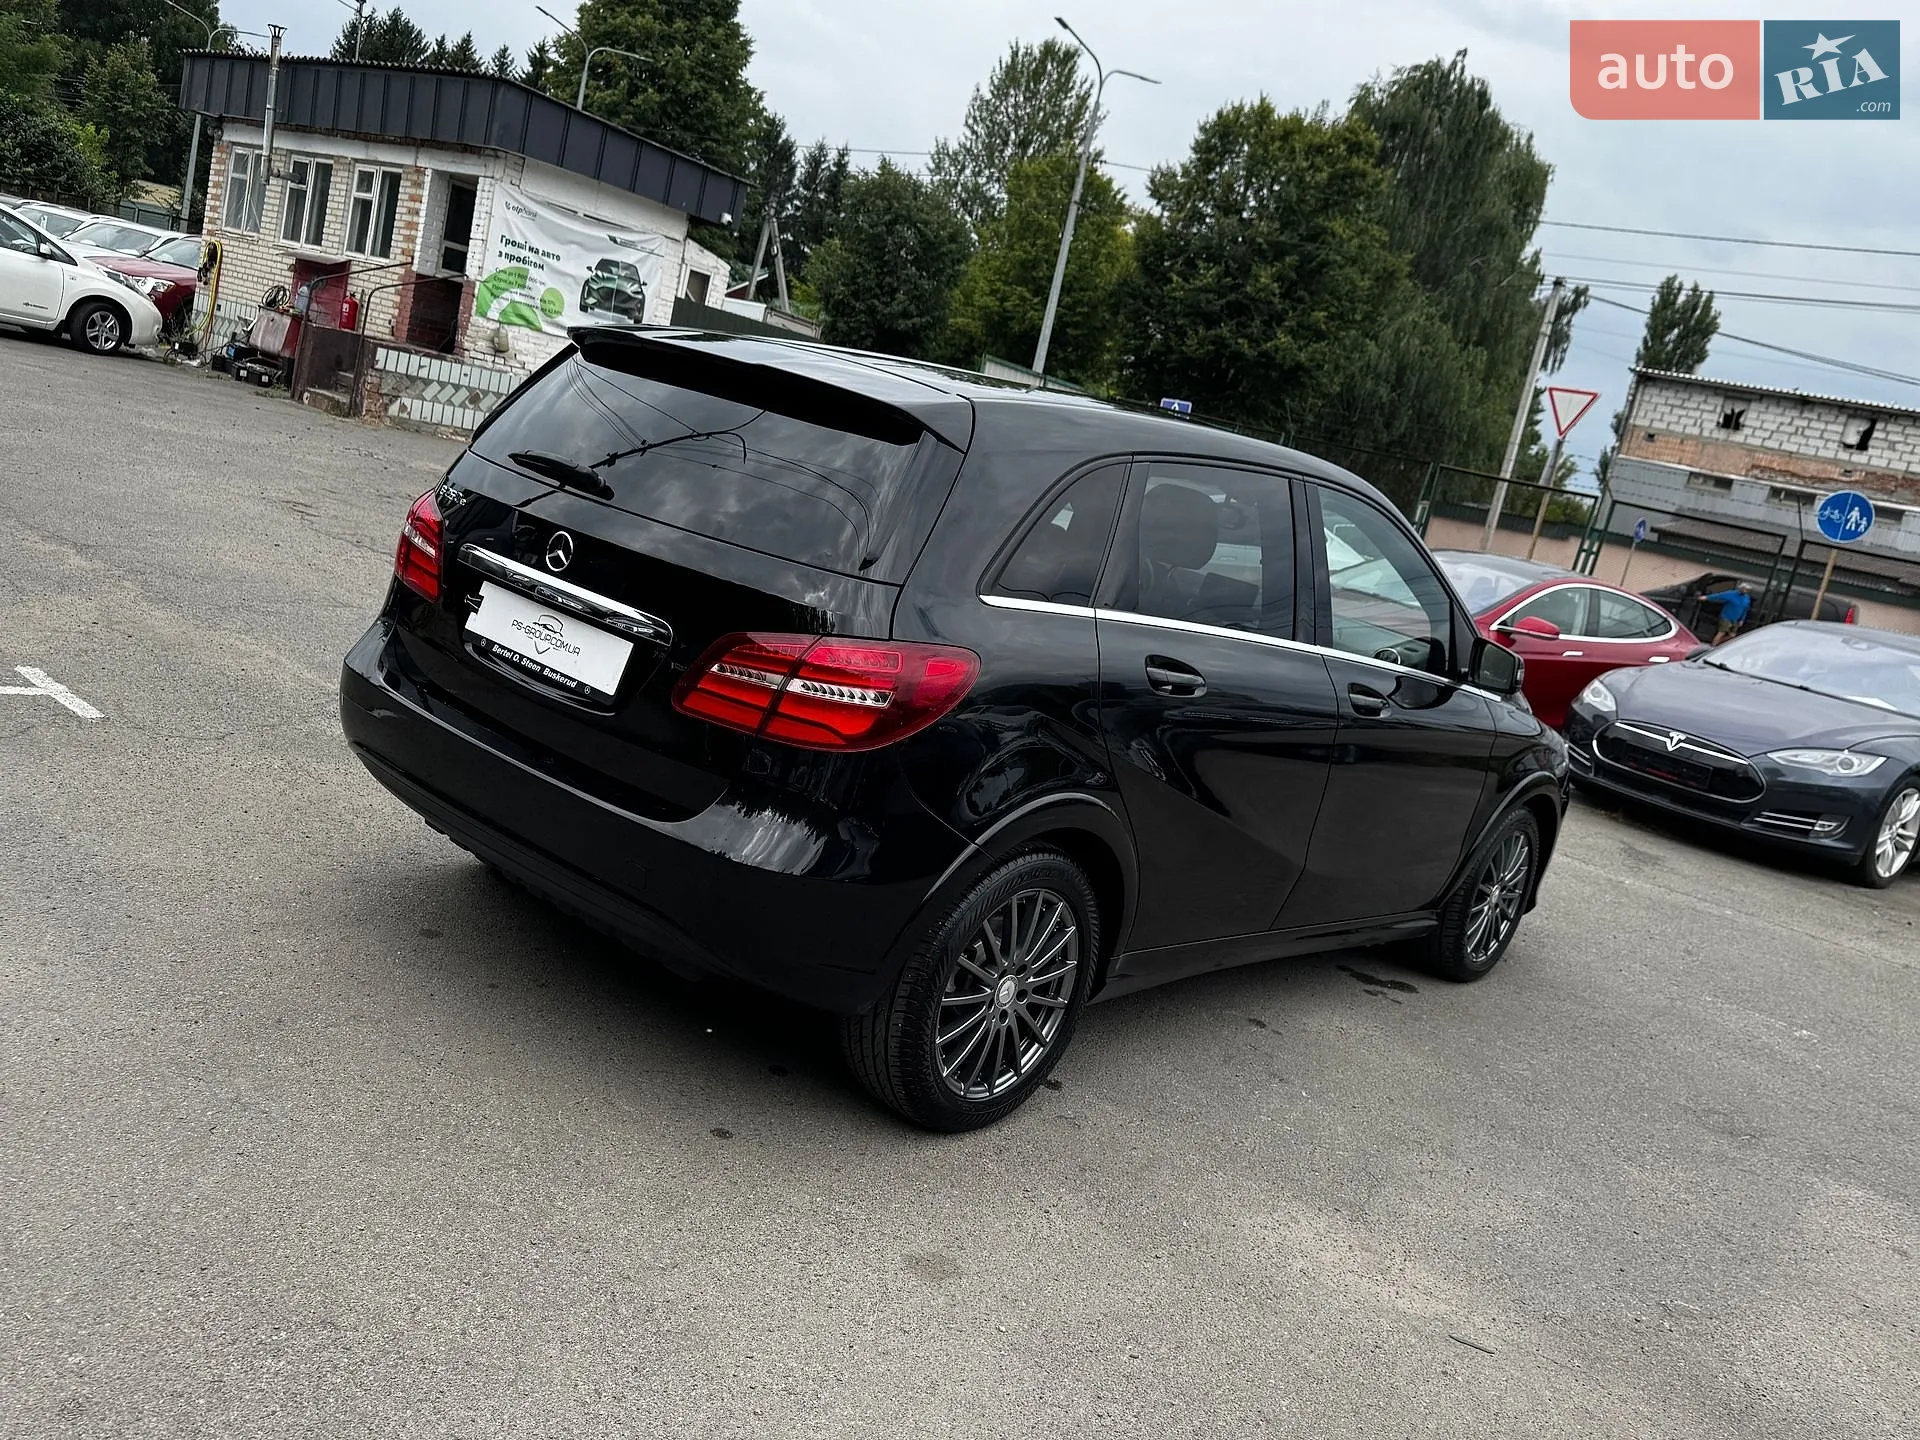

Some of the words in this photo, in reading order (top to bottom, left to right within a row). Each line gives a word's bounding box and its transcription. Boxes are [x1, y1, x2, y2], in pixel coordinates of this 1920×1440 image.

[500, 234, 527, 251] Гроші
[528, 244, 540, 256] на
[541, 249, 561, 261] авто
[504, 251, 545, 271] пробігом
[492, 644, 513, 659] Bertel
[513, 653, 520, 663] O.
[521, 657, 541, 672] Steen
[543, 667, 578, 688] Buskerud
